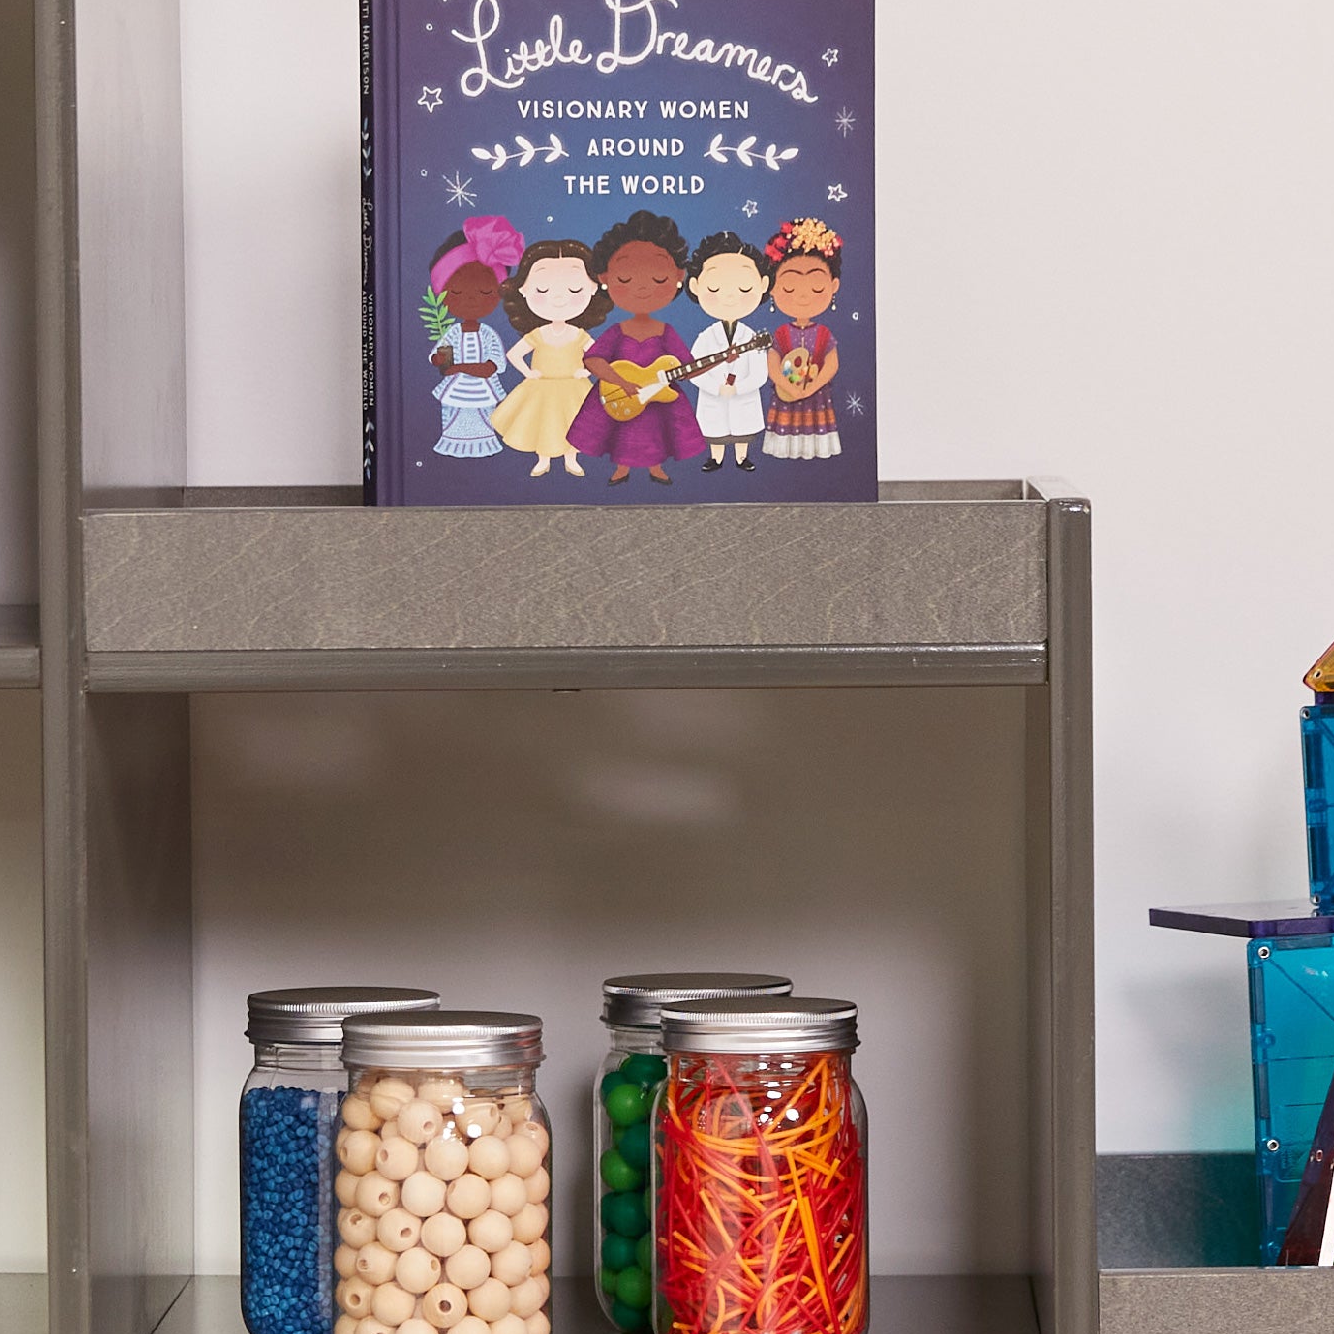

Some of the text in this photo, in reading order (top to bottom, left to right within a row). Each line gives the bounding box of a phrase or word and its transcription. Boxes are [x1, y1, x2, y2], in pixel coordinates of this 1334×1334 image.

[517, 101, 749, 119] VISIONARY WOMEN
[587, 139, 684, 156] AROUND
[564, 176, 705, 194] THE WORLD
